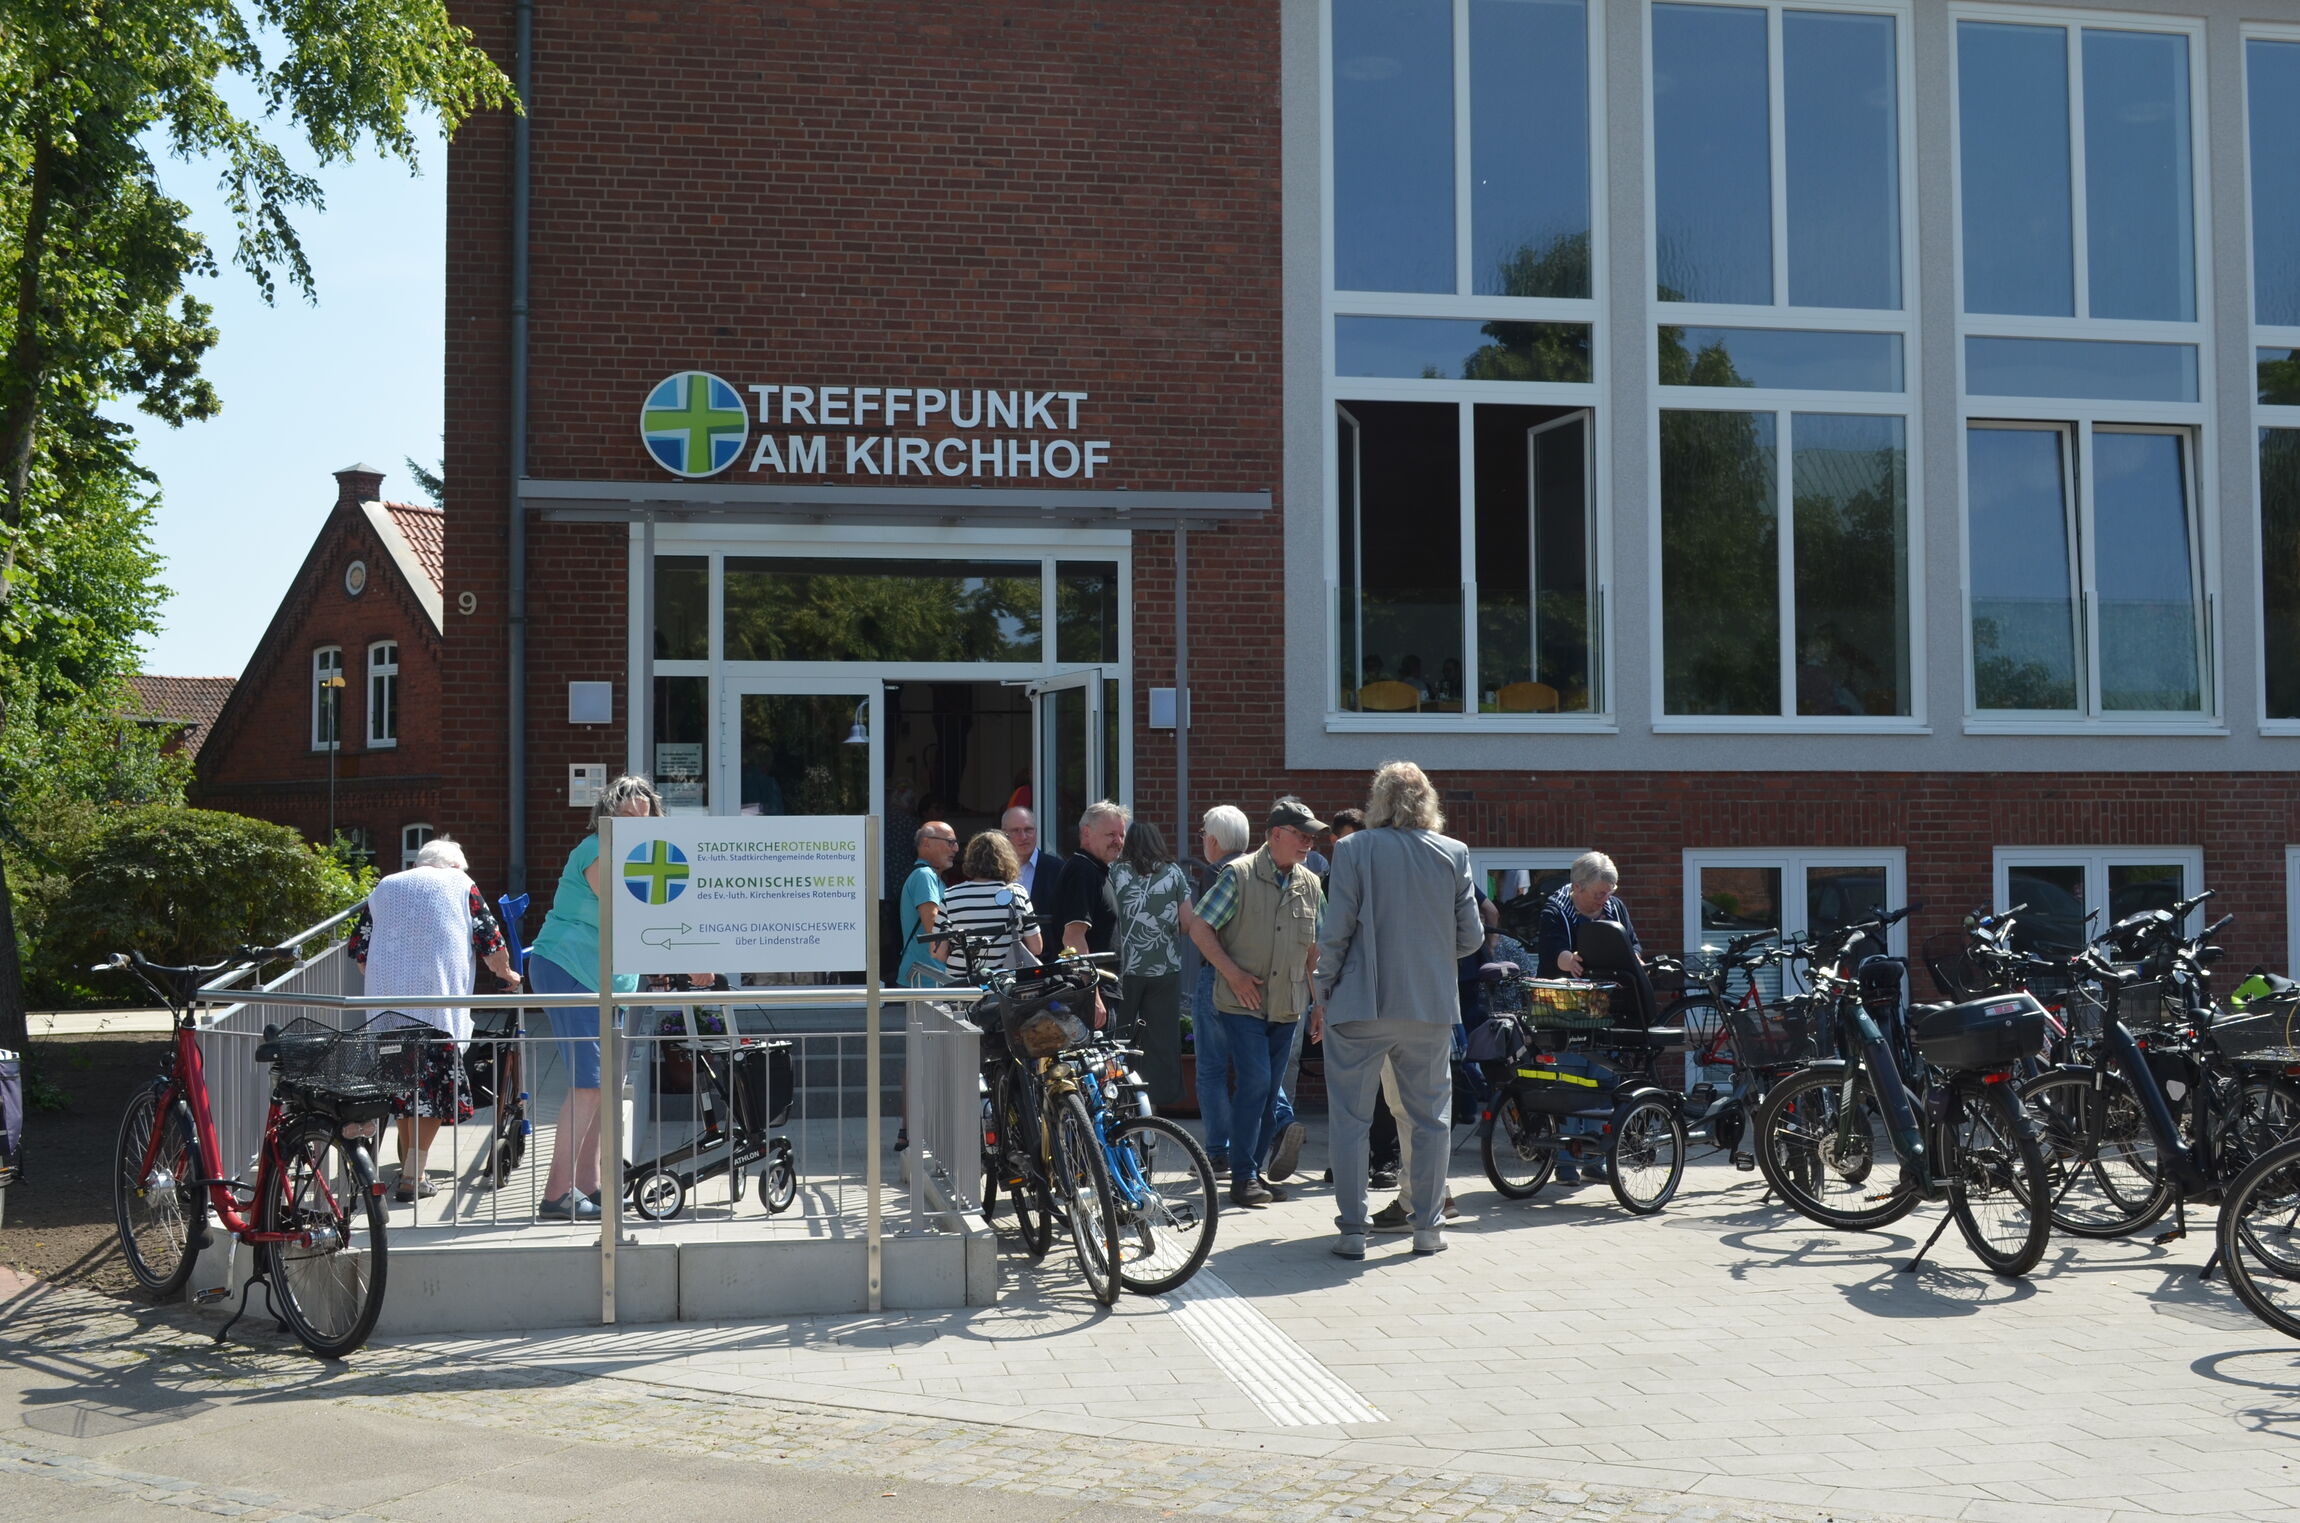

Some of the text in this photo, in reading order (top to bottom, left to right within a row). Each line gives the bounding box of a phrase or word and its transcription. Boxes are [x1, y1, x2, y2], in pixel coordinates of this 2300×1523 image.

[748, 384, 1088, 430] TREFFPUNKT
[748, 435, 1111, 479] AM KIRCHHOF
[458, 591, 477, 616] 9
[697, 841, 856, 852] STADTKIRCHEROTENBURG
[697, 853, 856, 862] Ev.-luth. Stadtkirchengemeinde Rotenburg
[697, 877, 856, 888] DIAKONISCHESWERK
[697, 890, 856, 900] des Ev.-luth. Kirchenkreises Rotenburg
[699, 922, 856, 933] EINGANG DIAKONISCHESWERK
[735, 935, 821, 945] über Lindenstraße
[734, 1151, 760, 1165] ATHLON
